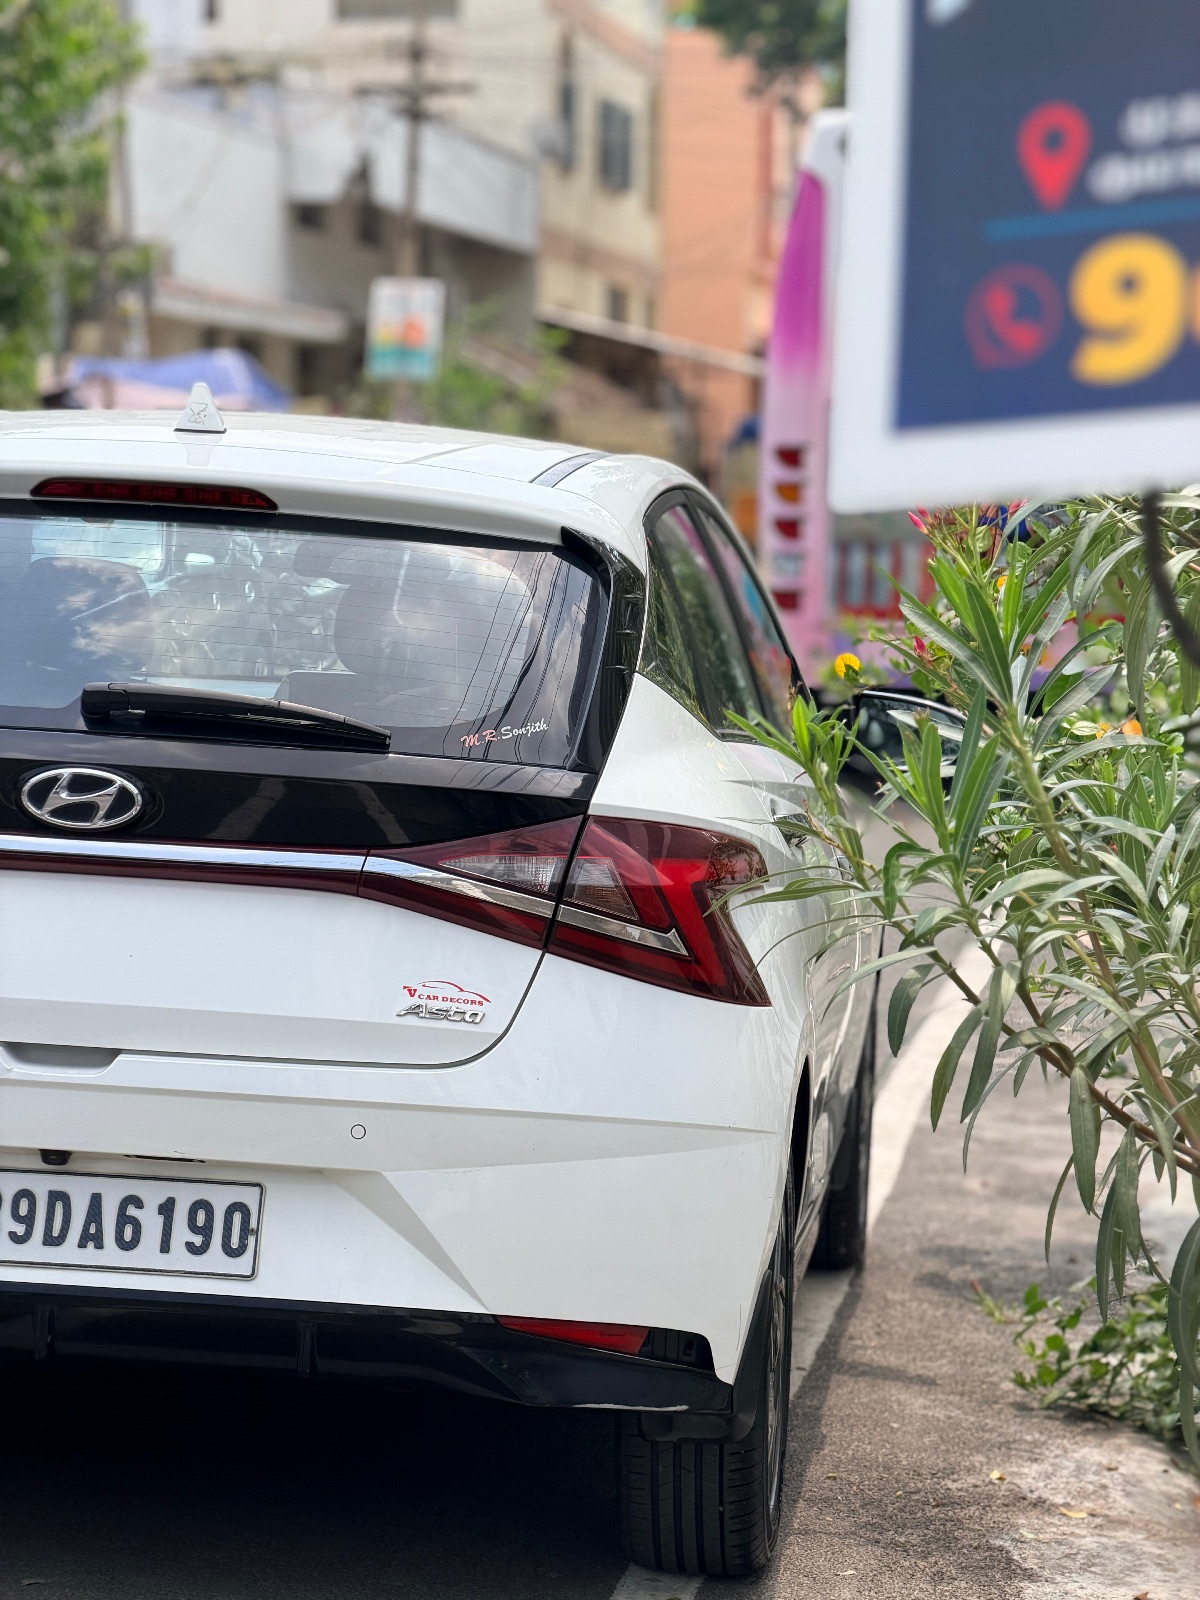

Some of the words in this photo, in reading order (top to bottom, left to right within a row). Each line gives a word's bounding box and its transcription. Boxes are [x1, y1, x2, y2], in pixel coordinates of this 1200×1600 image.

[1070, 232, 1200, 387] 9
[396, 1002, 486, 1024] Asta
[418, 993, 439, 1001] CAR
[442, 996, 484, 1006] DECORS
[0, 1188, 251, 1258] 9DA6190
